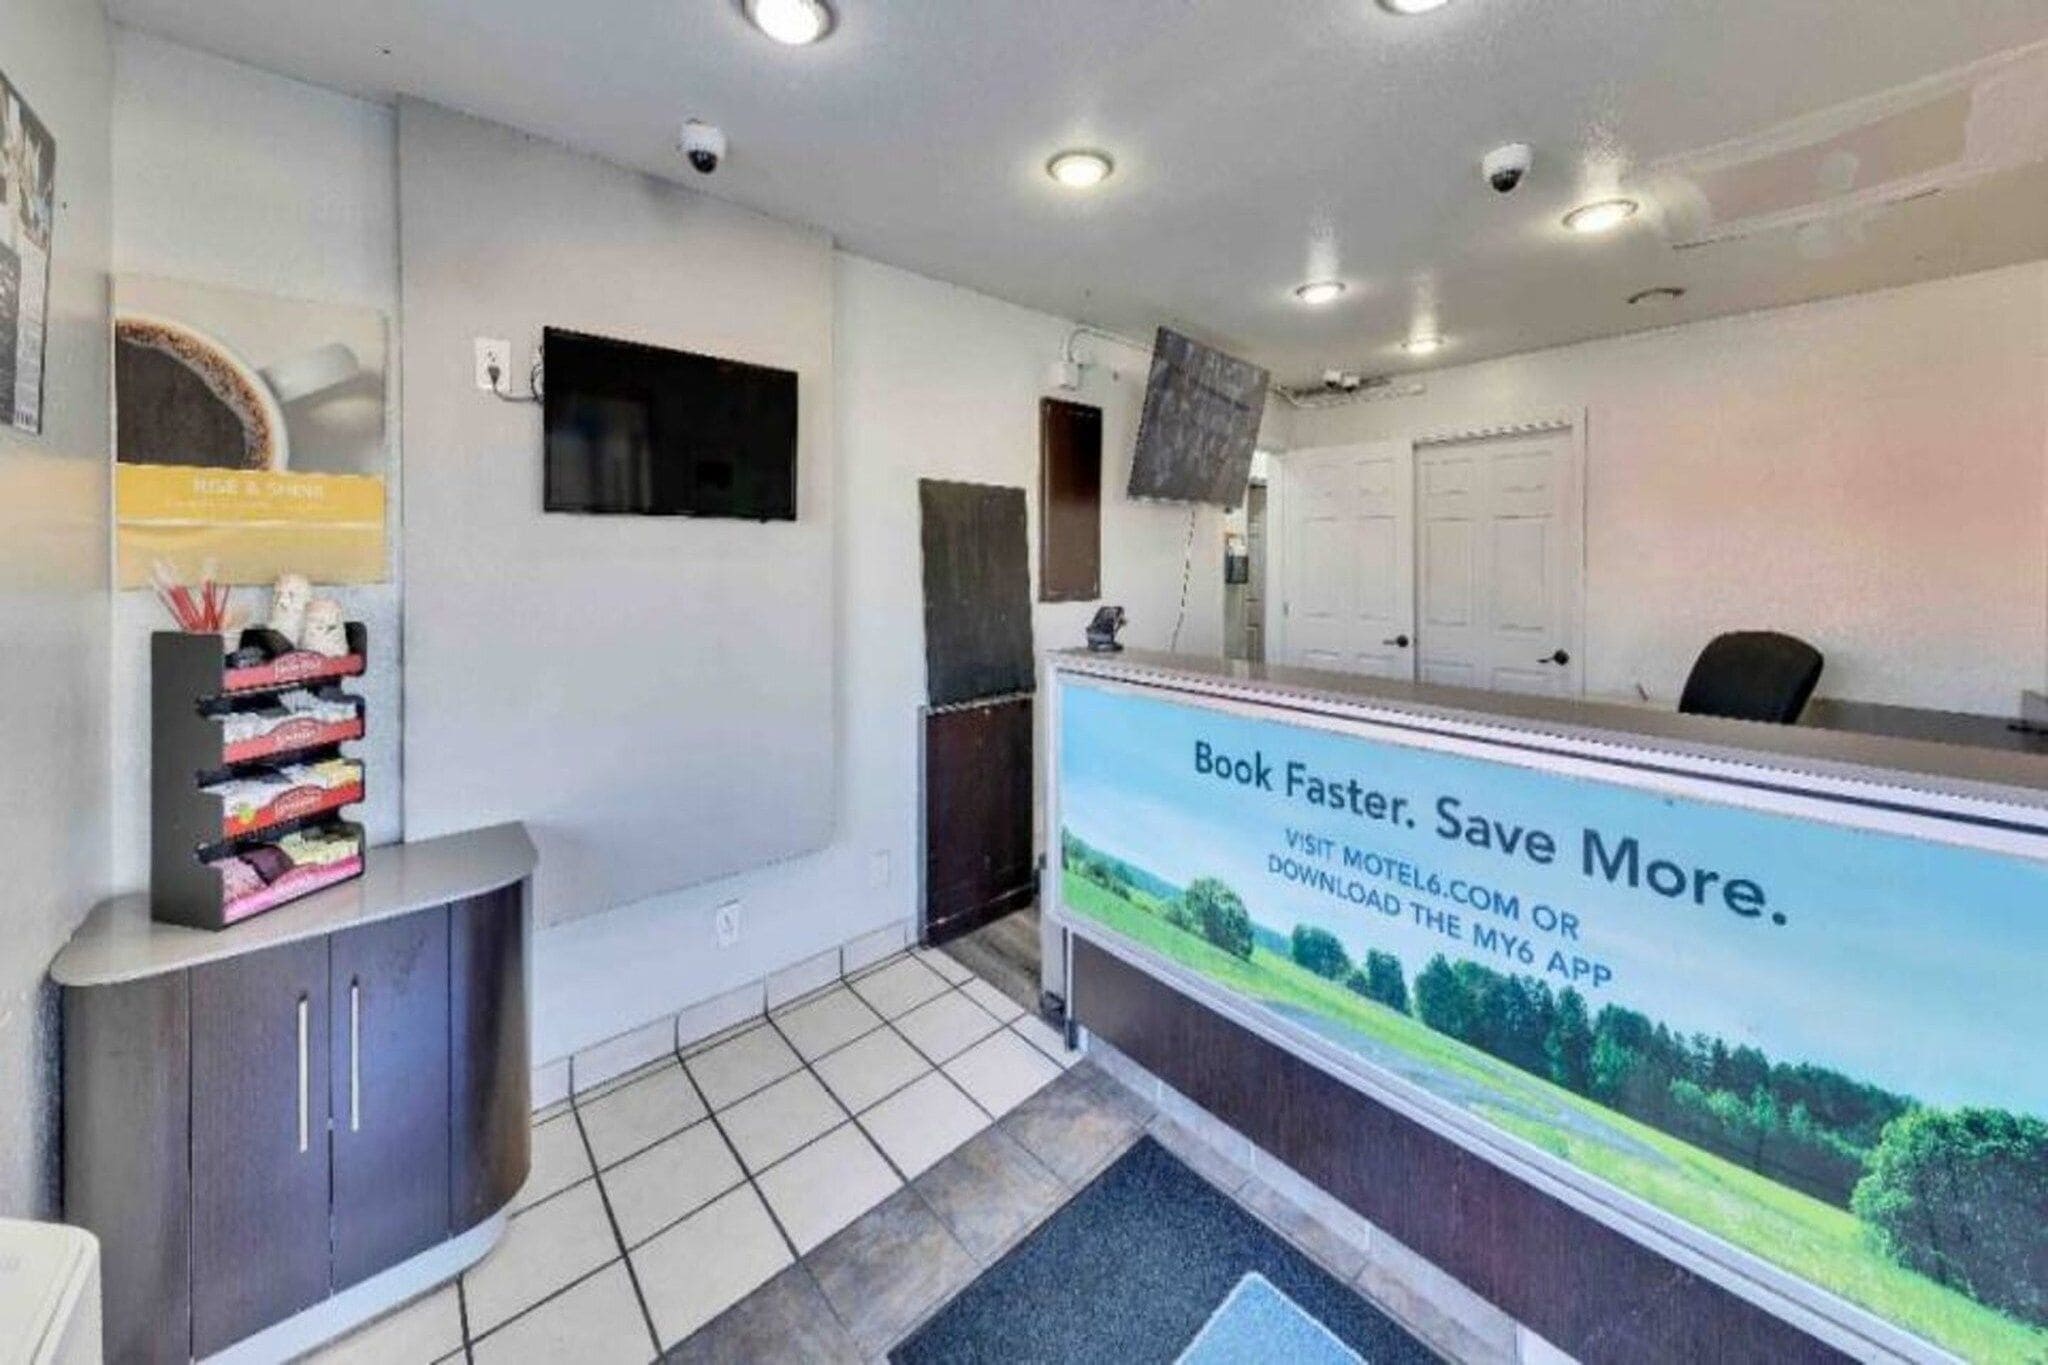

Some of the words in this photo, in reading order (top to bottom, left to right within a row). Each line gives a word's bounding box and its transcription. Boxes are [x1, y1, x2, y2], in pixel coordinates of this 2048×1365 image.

[1194, 740, 1273, 792] Book
[1286, 760, 1416, 830] Faster.
[1435, 795, 1557, 865] Save
[1582, 827, 1787, 927] More.
[1284, 827, 1336, 861] VISIT
[1342, 845, 1520, 922] MOTEL6.COM
[1531, 903, 1580, 942] OR
[1268, 853, 1401, 917] DOWNLOAD
[1409, 901, 1463, 941] THE
[1472, 922, 1535, 966] MY6
[1546, 949, 1613, 989] APP
